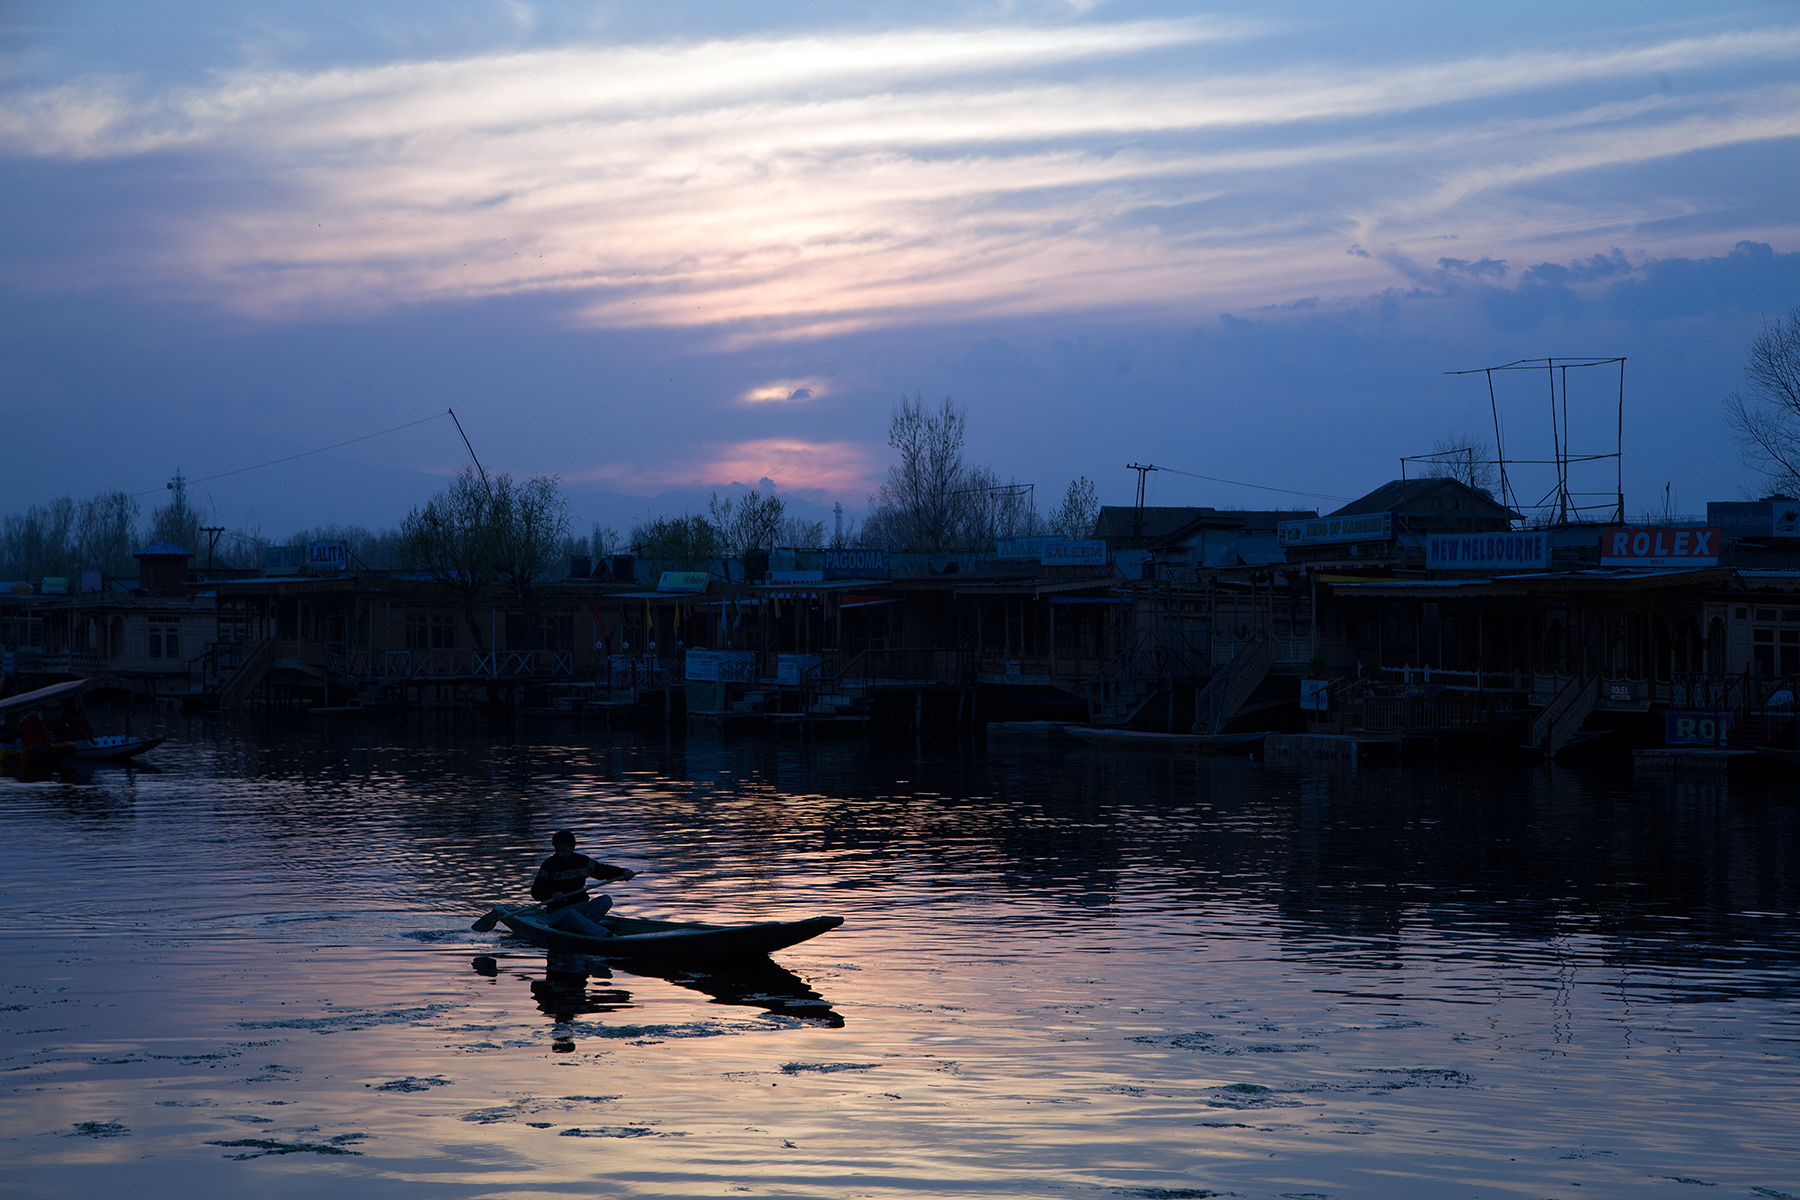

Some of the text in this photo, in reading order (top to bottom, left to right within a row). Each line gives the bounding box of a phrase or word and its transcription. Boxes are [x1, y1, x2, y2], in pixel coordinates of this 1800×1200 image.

[1307, 522, 1327, 537] KING
[1329, 520, 1342, 536] OF
[1342, 518, 1382, 534] KASHMIR
[1723, 513, 1738, 526] New
[1044, 546, 1103, 558] SALEEM
[1431, 537, 1542, 562] NEW MELBOURNE
[1612, 531, 1713, 556] ROLEX
[309, 546, 345, 562] LALITA
[825, 551, 884, 569] PAGOOMA
[1611, 686, 1629, 695] ROLEX
